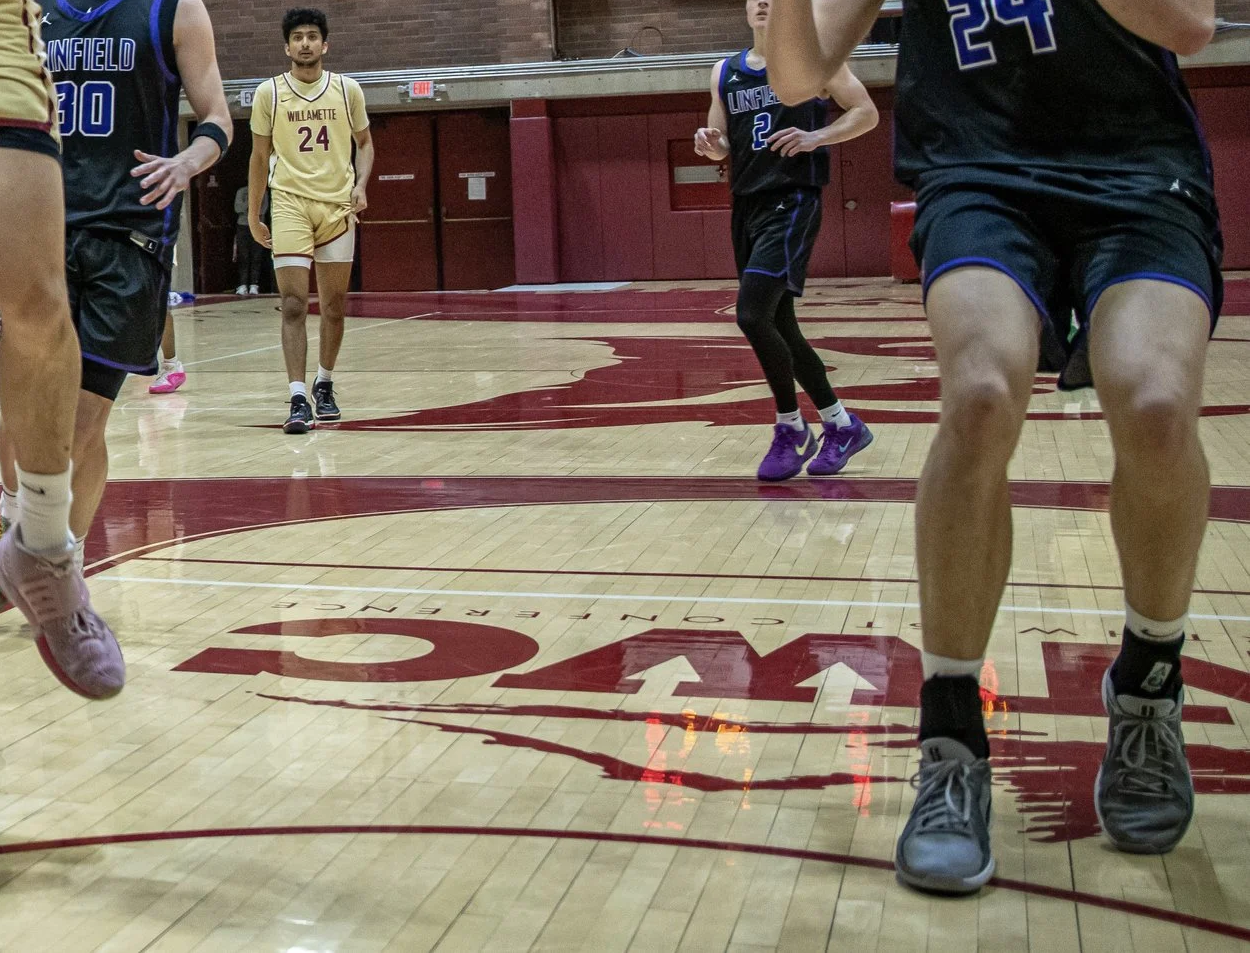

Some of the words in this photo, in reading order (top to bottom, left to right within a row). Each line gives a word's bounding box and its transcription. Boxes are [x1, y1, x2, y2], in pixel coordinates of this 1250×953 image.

[47, 37, 136, 72] INFIELD
[54, 80, 115, 137] 30
[727, 85, 782, 115] LINFIE
[287, 109, 337, 122] WILLAMETTE
[297, 125, 330, 153] 24
[752, 112, 771, 151] 2
[271, 600, 785, 626] CONFERENCE
